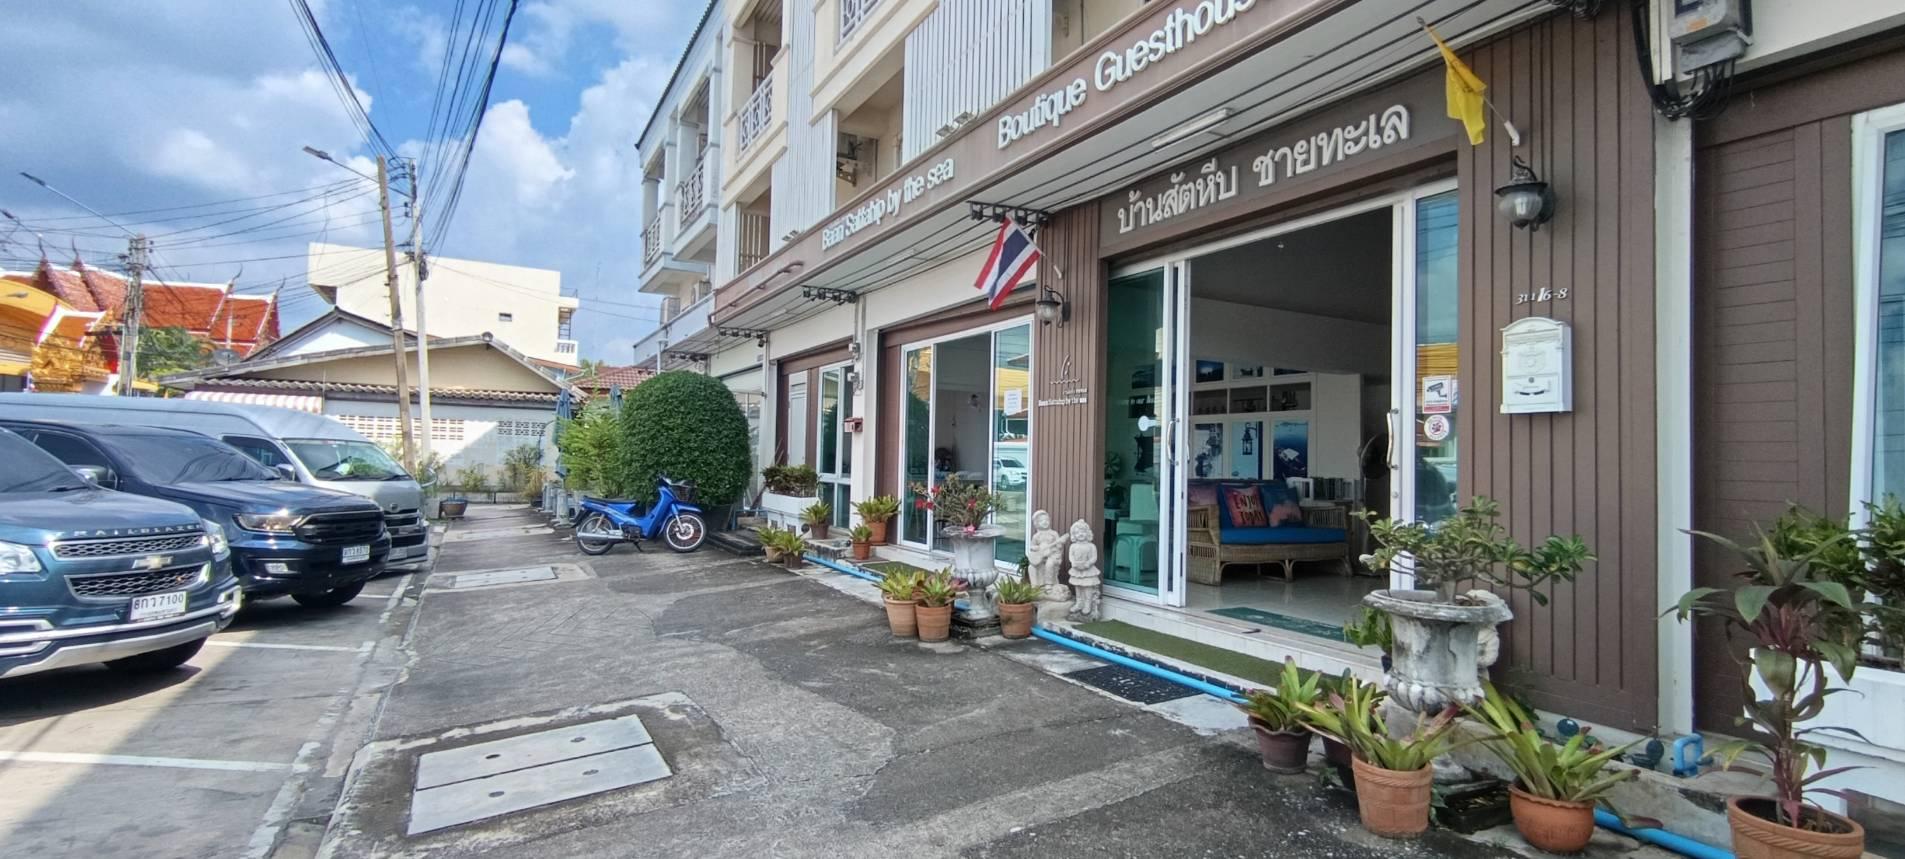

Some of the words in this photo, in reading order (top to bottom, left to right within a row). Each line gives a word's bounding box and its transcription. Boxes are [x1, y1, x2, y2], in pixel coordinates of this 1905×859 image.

[998, 77, 1088, 149] Boutique
[887, 189, 902, 216] by
[903, 175, 925, 203] the
[927, 158, 955, 189] sea
[1118, 157, 1240, 234] บ้านสัตหีบ
[1252, 104, 1410, 188] ชายทะเล
[159, 593, 184, 607] 7100
